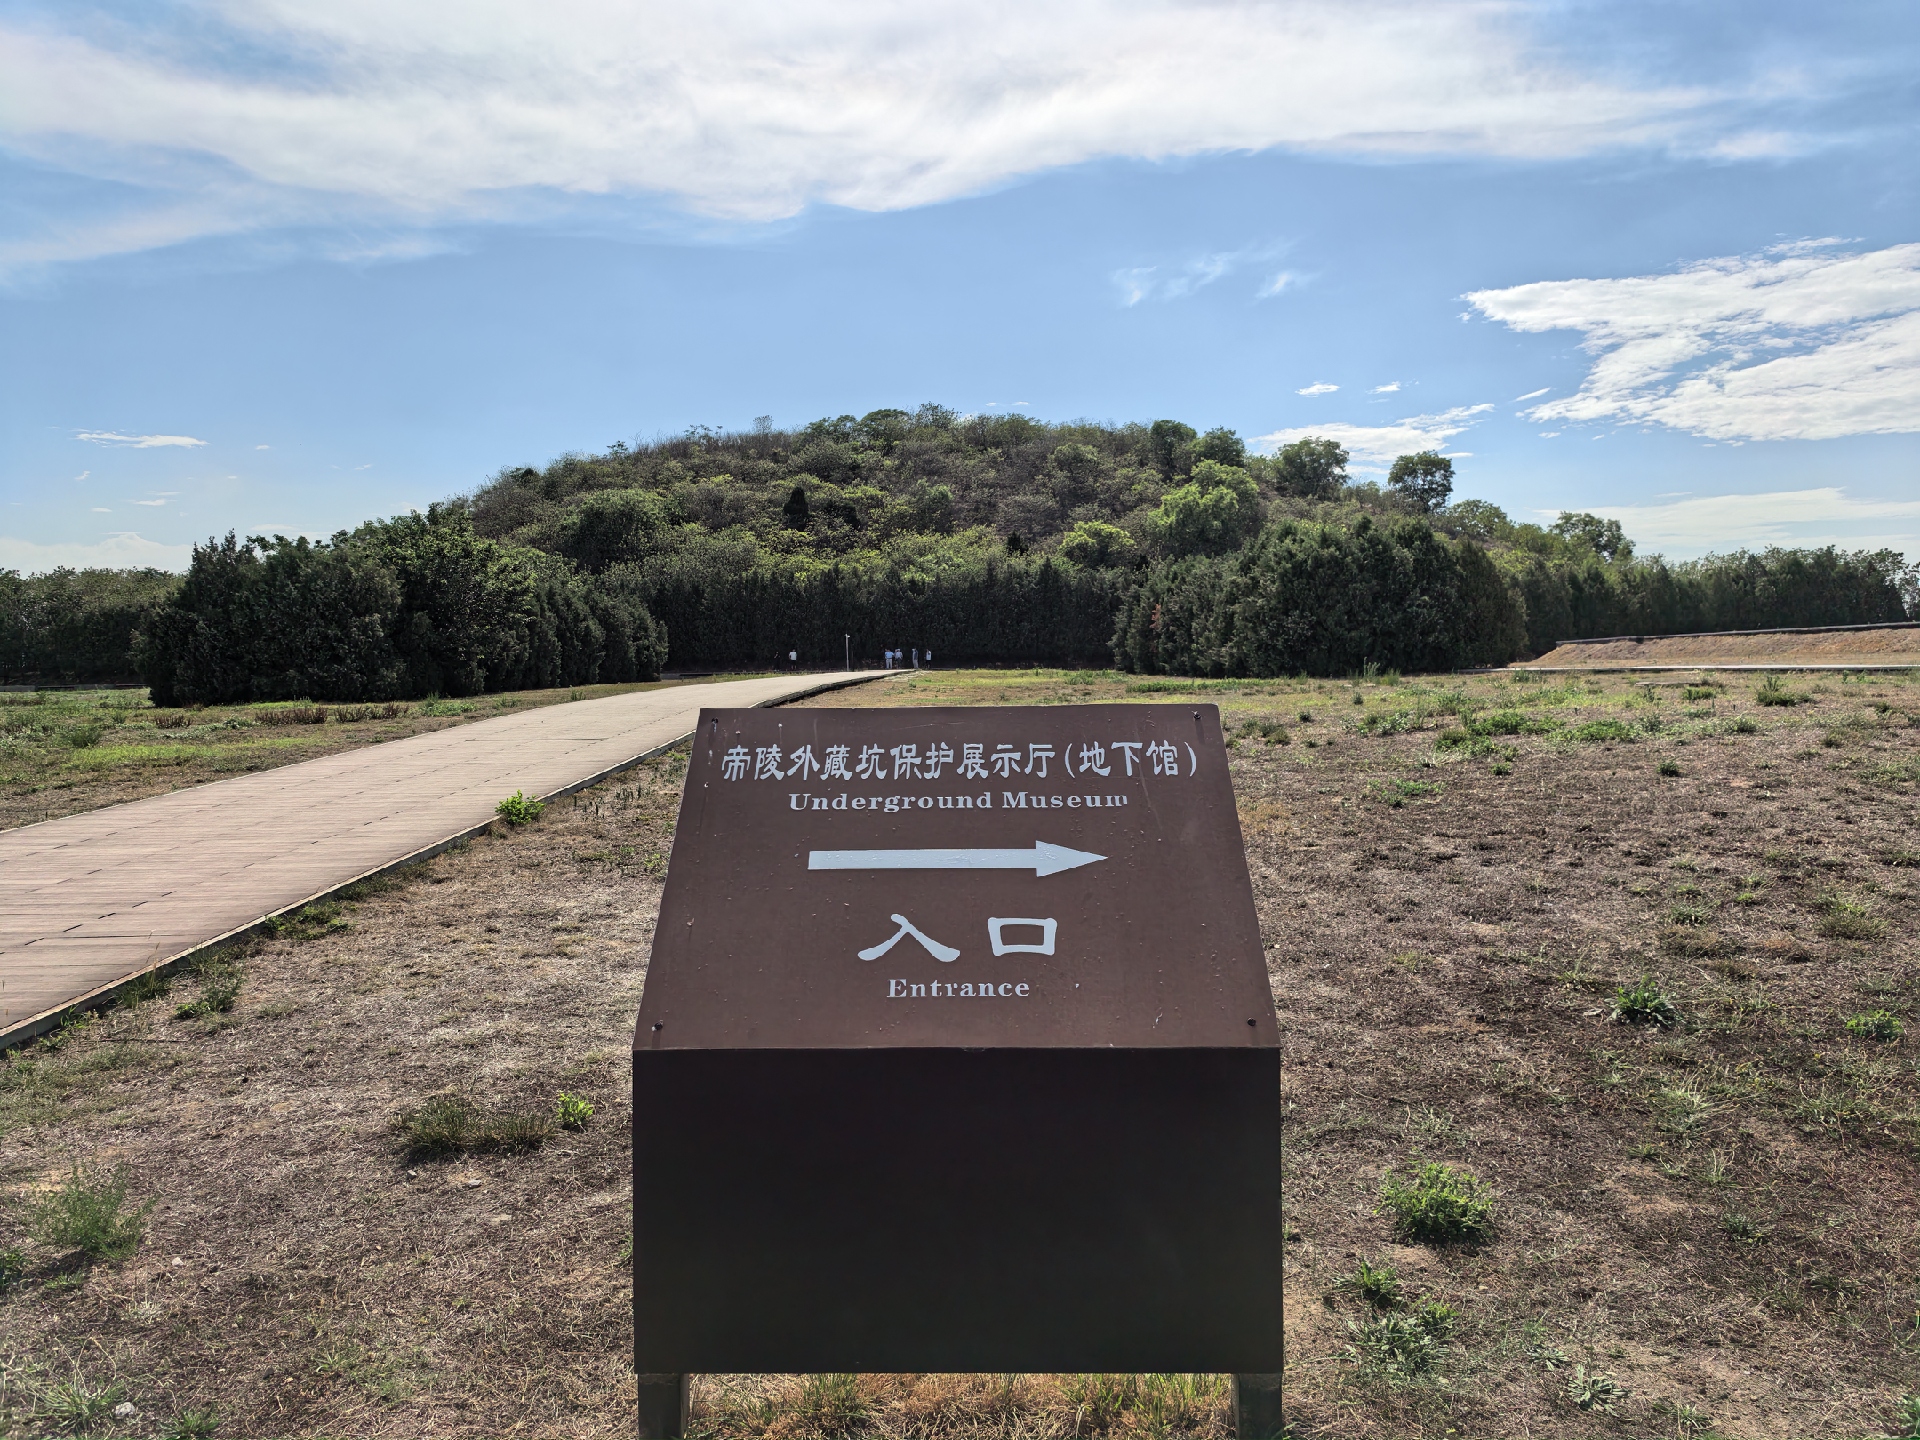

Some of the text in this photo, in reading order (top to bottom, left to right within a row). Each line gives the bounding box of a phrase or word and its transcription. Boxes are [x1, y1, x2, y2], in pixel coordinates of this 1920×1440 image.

[721, 739, 1198, 782] 帝陵外藏坑保护展示厅(地下馆)
[788, 791, 1129, 813] Underground Museum
[857, 913, 1058, 963] 入口
[886, 978, 1030, 998] Entrance
